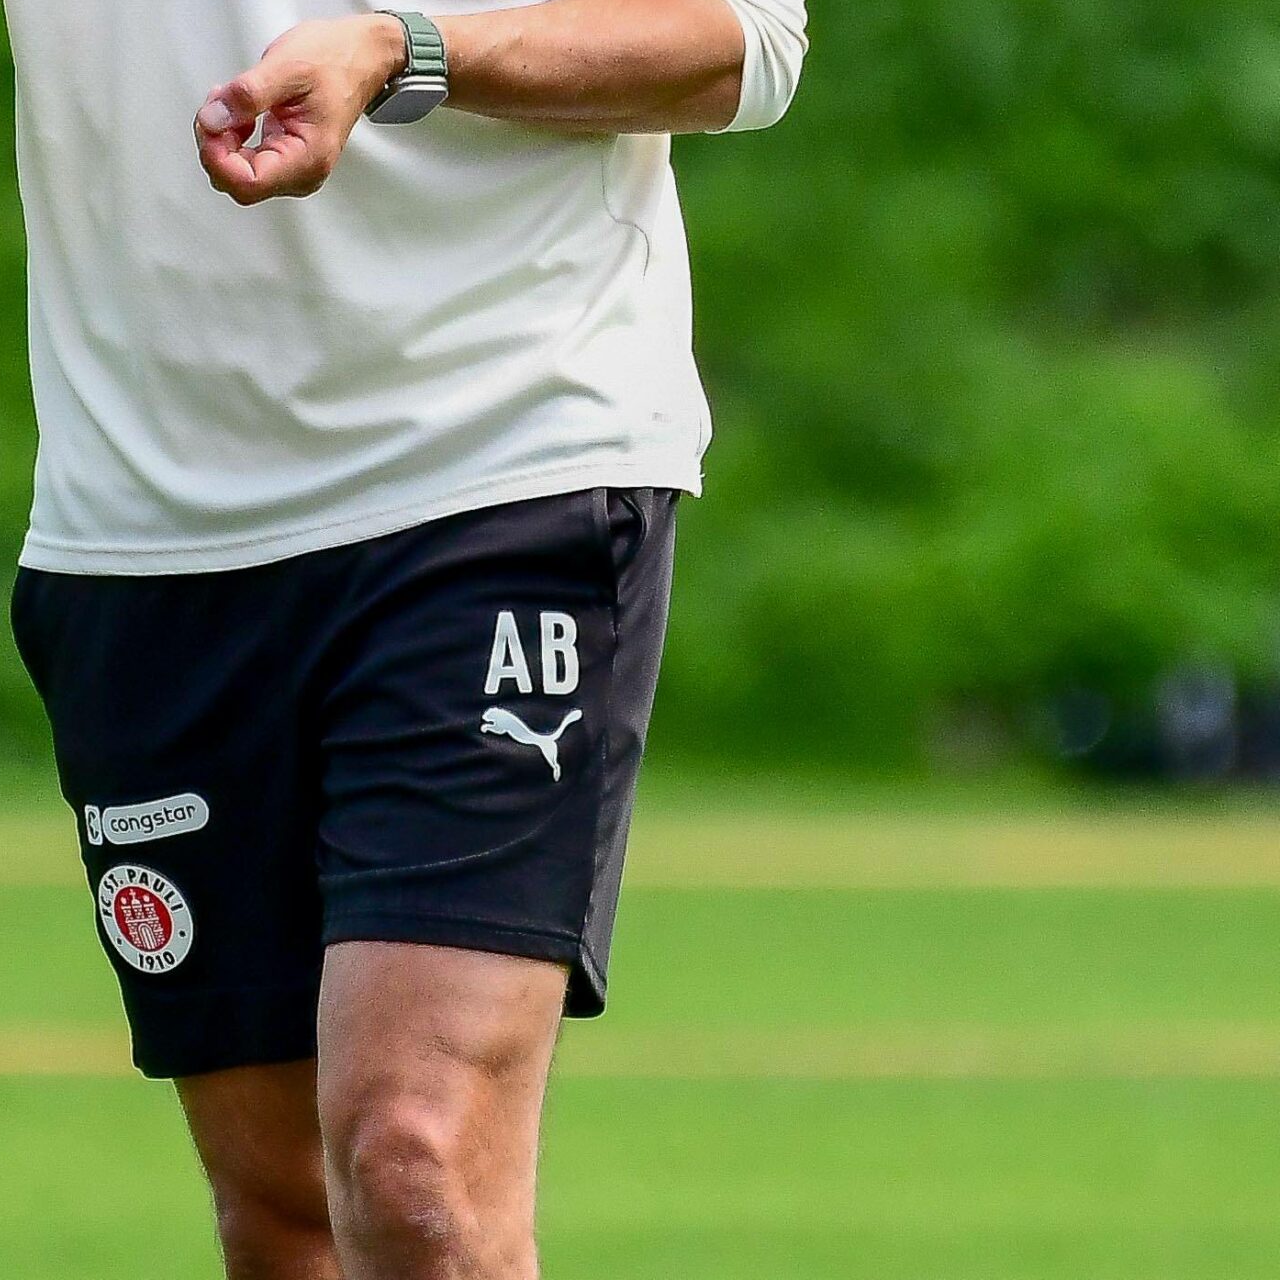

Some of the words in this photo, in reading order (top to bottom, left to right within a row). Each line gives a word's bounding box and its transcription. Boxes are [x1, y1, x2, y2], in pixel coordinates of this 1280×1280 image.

[484, 611, 579, 694] AB
[111, 805, 196, 833] congstar
[104, 873, 124, 894] ST.
[126, 868, 184, 912] PAULI
[101, 895, 113, 918] FC
[138, 951, 175, 971] 1910
